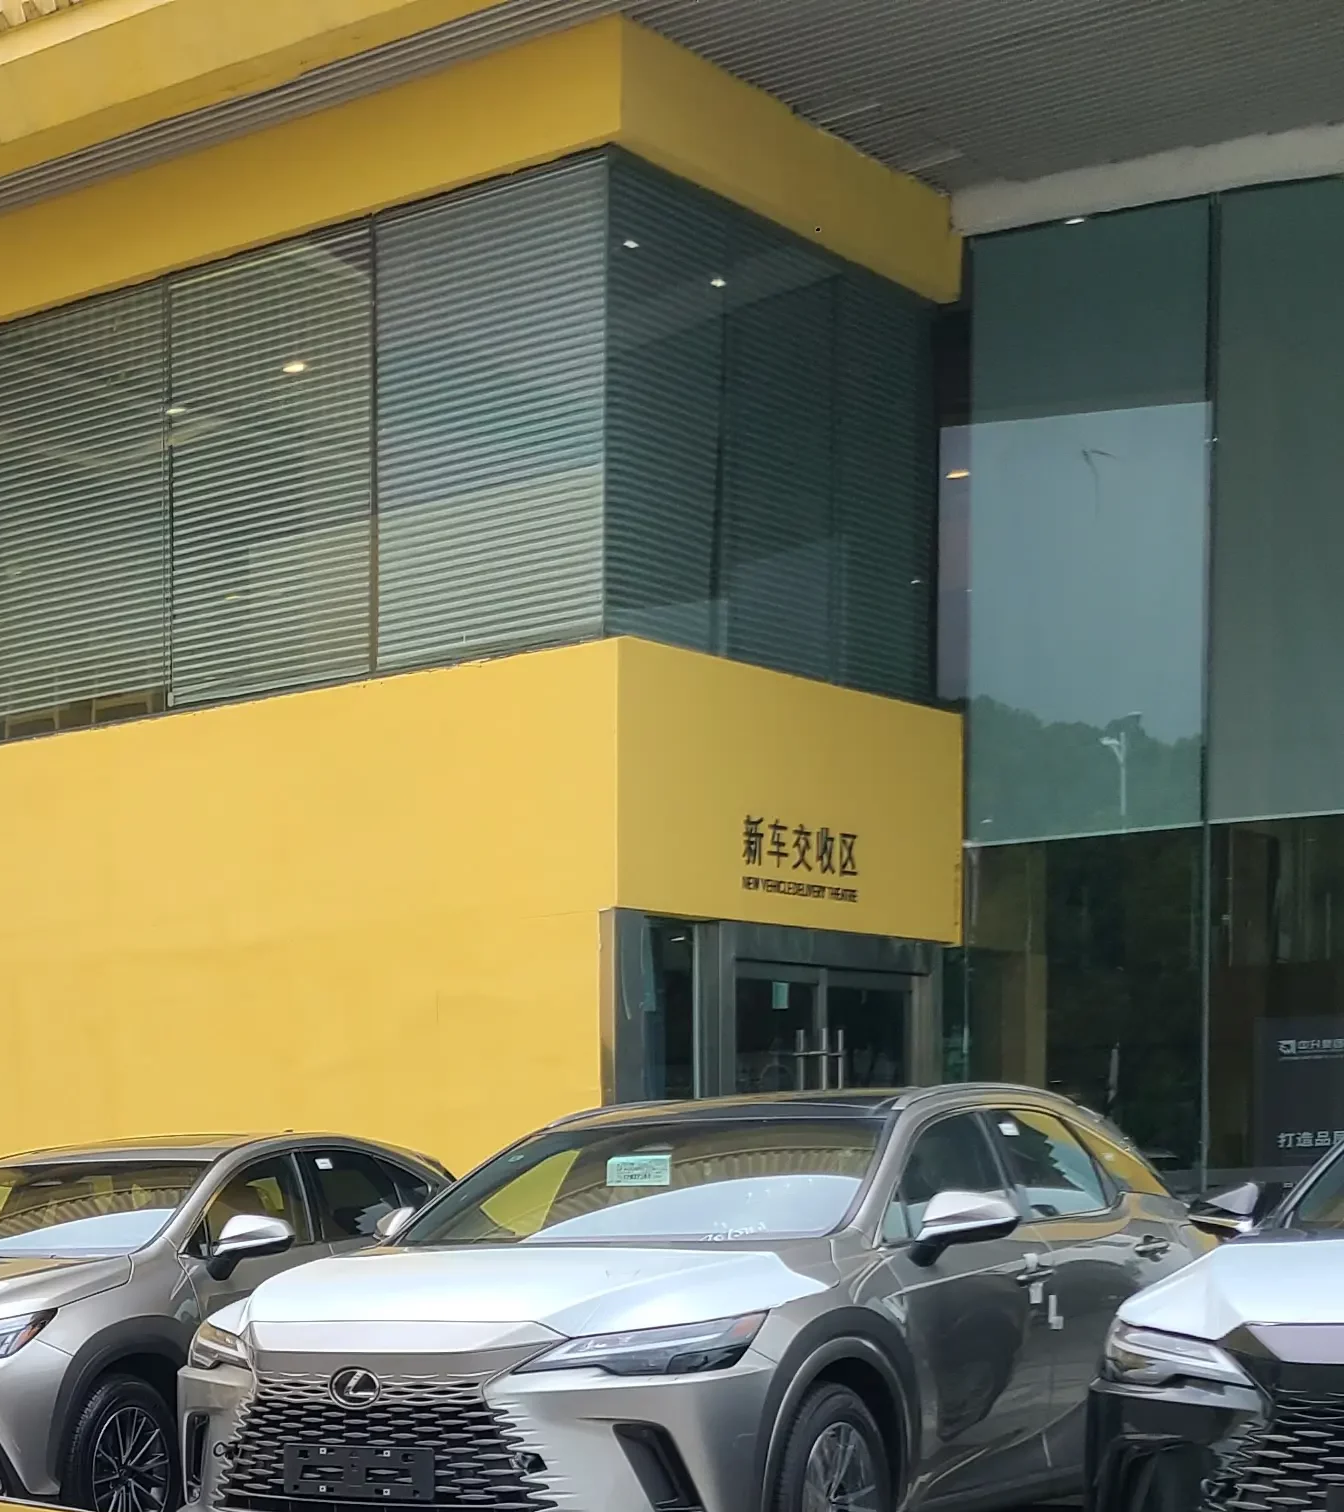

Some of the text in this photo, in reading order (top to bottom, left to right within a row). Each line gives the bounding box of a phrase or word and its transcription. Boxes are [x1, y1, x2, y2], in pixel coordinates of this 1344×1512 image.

[742, 815, 858, 877] 新车交收区
